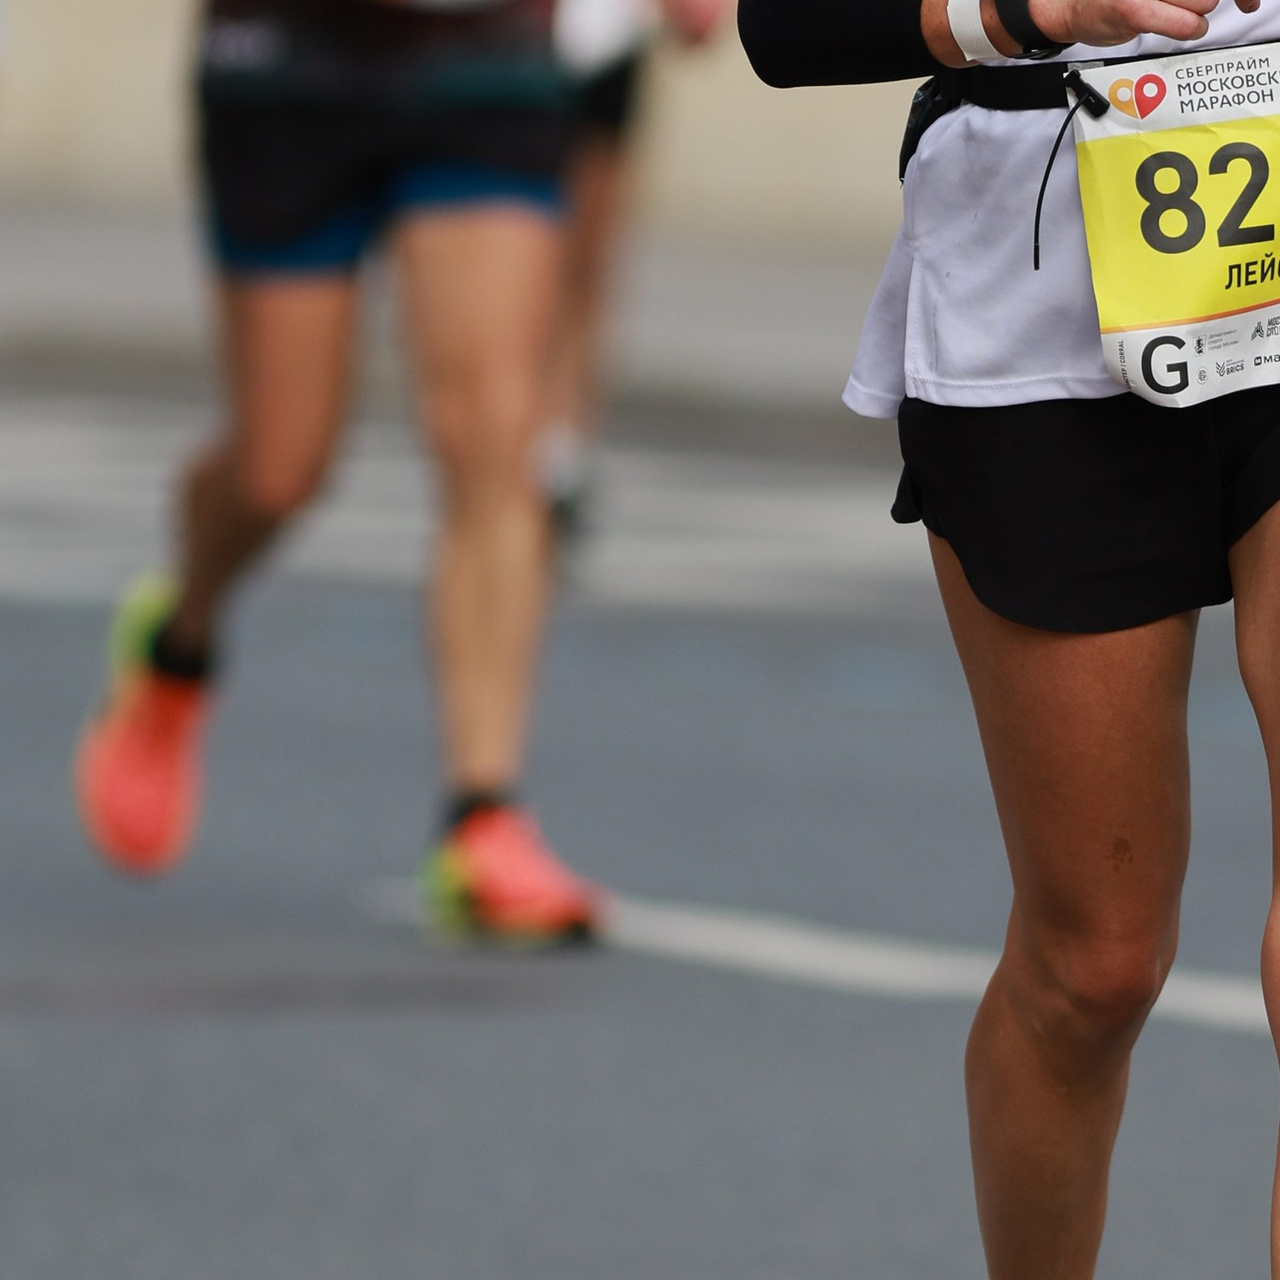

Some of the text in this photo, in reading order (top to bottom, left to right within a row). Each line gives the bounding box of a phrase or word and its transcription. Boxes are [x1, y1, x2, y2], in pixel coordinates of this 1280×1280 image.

[1175, 57, 1270, 80] СБЕРПРАЙМ
[1179, 88, 1275, 114] МАРАФОН
[1118, 340, 1126, 363] CORRAL
[1141, 335, 1190, 395] G
